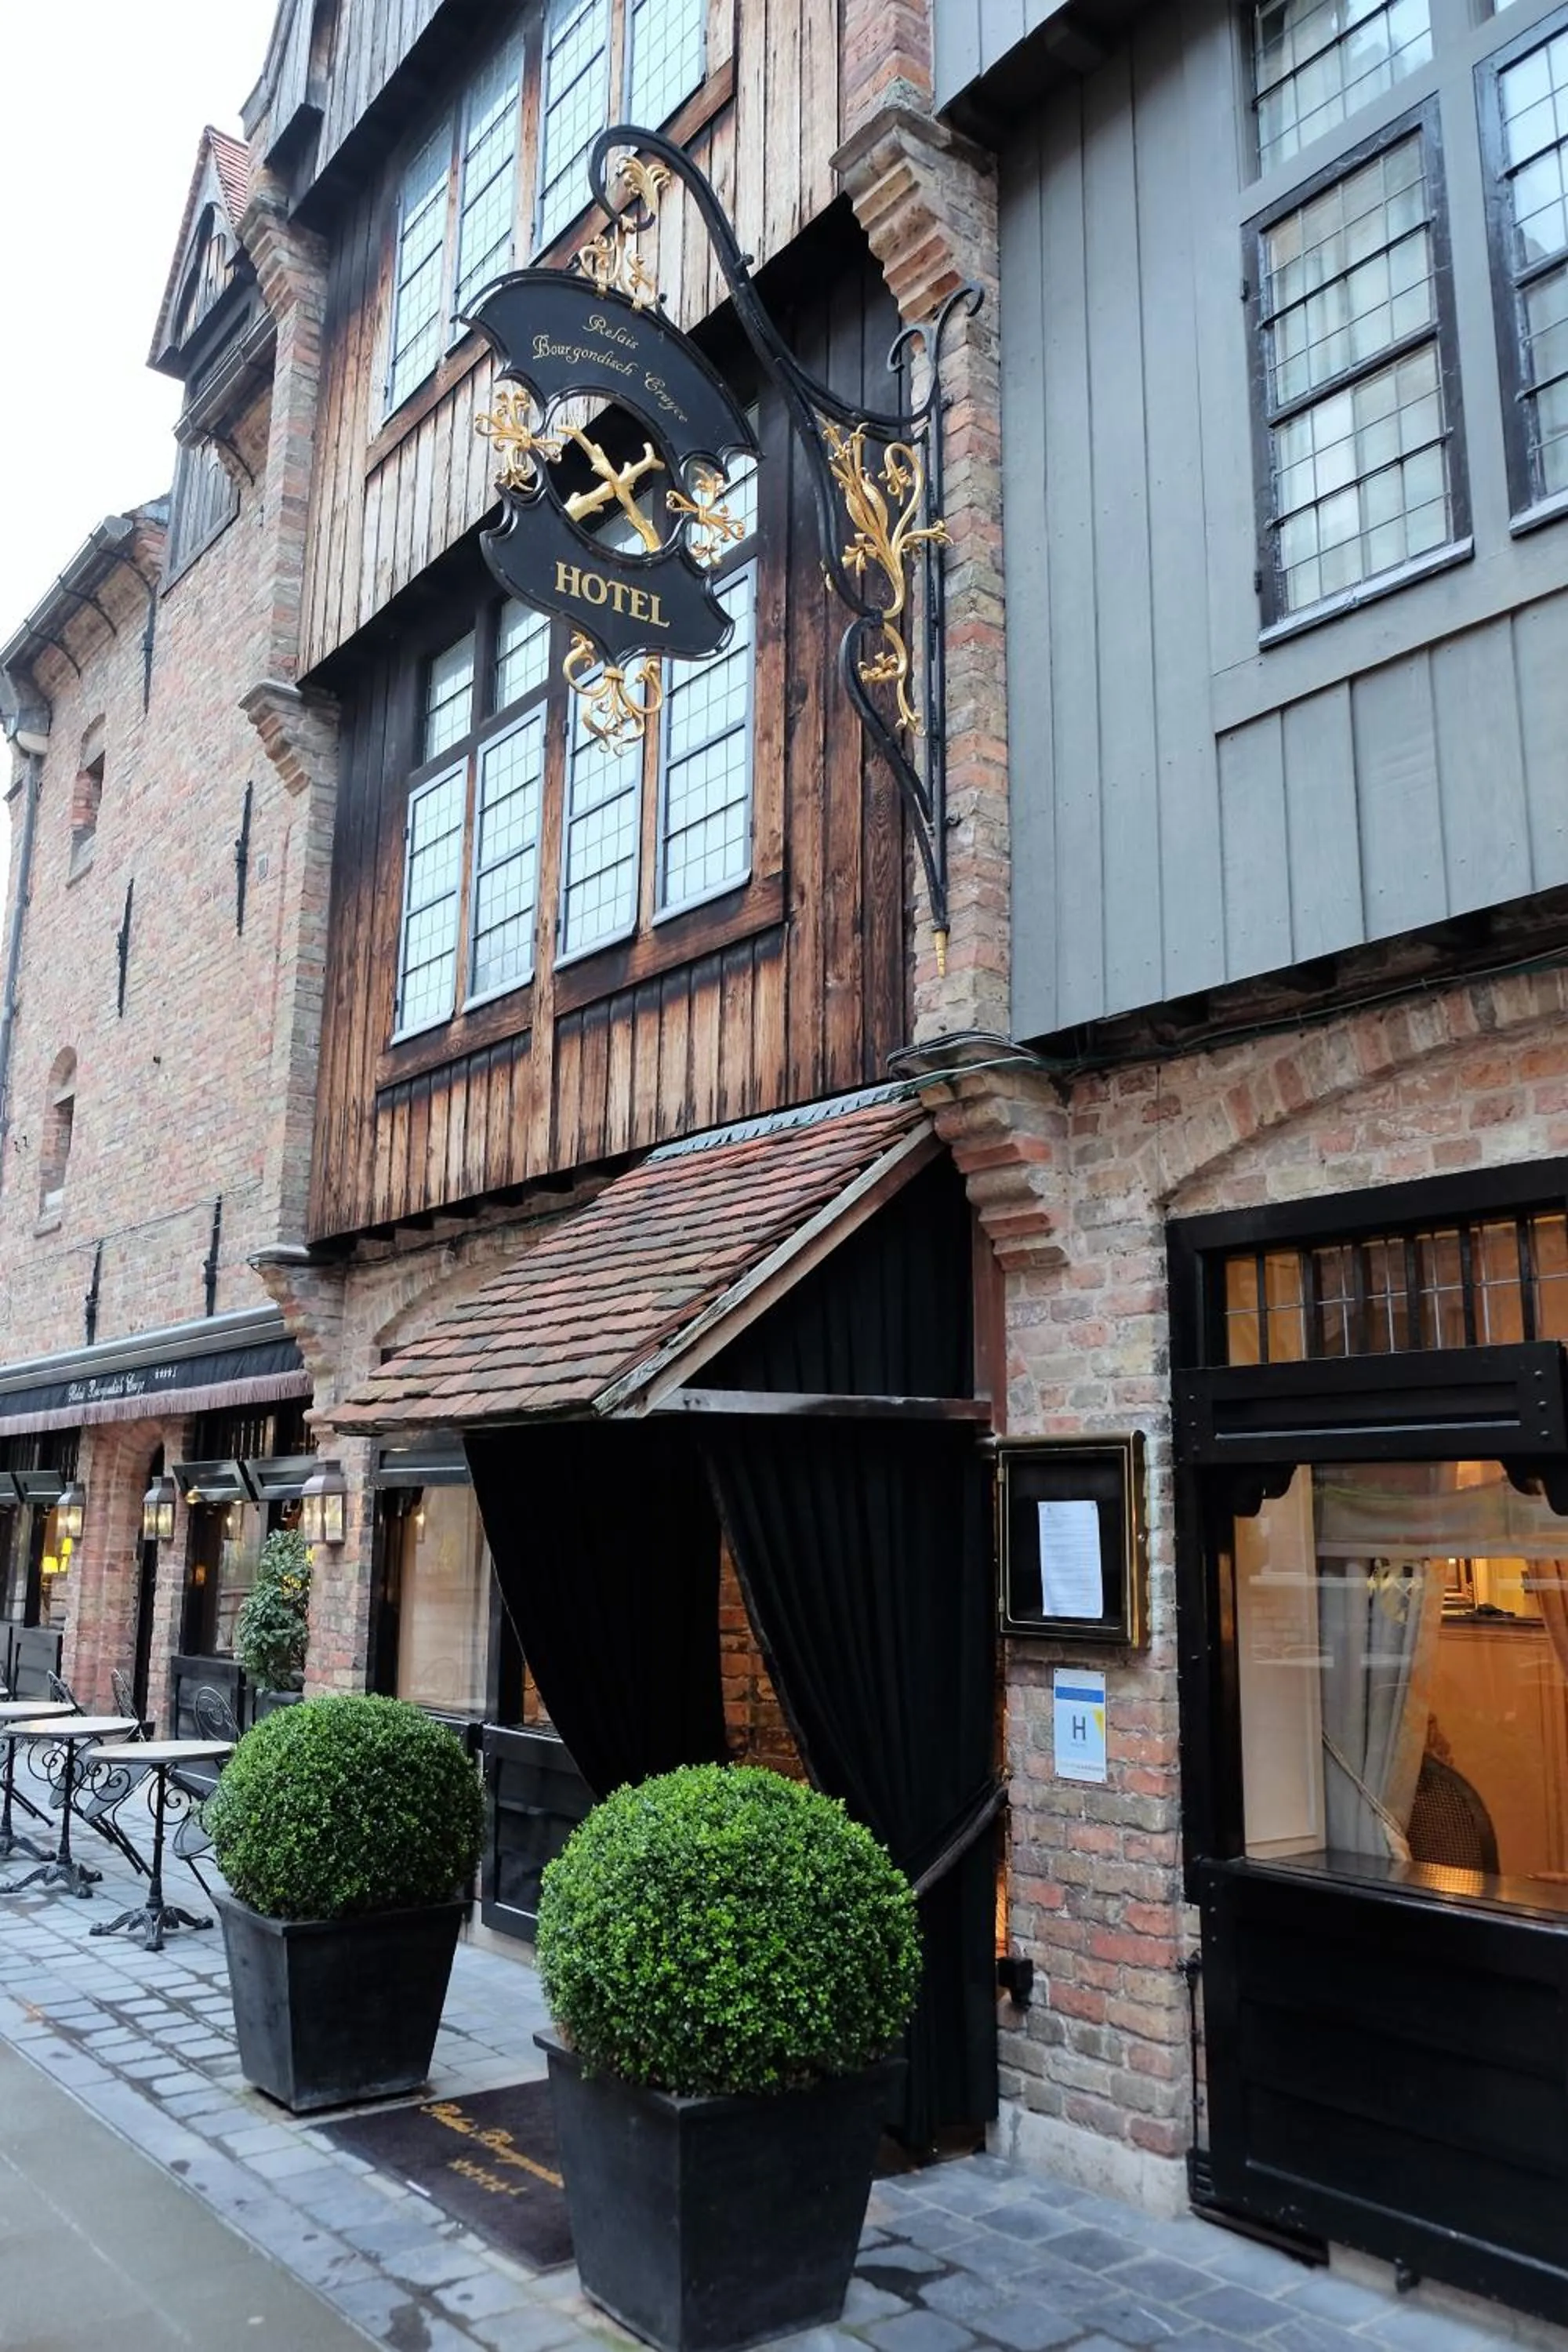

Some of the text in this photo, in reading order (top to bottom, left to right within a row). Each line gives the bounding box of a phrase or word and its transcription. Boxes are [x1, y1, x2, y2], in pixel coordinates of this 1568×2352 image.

[583, 314, 639, 350] Relais
[532, 334, 689, 423] Bourgondisch Cruyce
[554, 561, 670, 628] HOTEL
[1073, 1715, 1086, 1740] H
